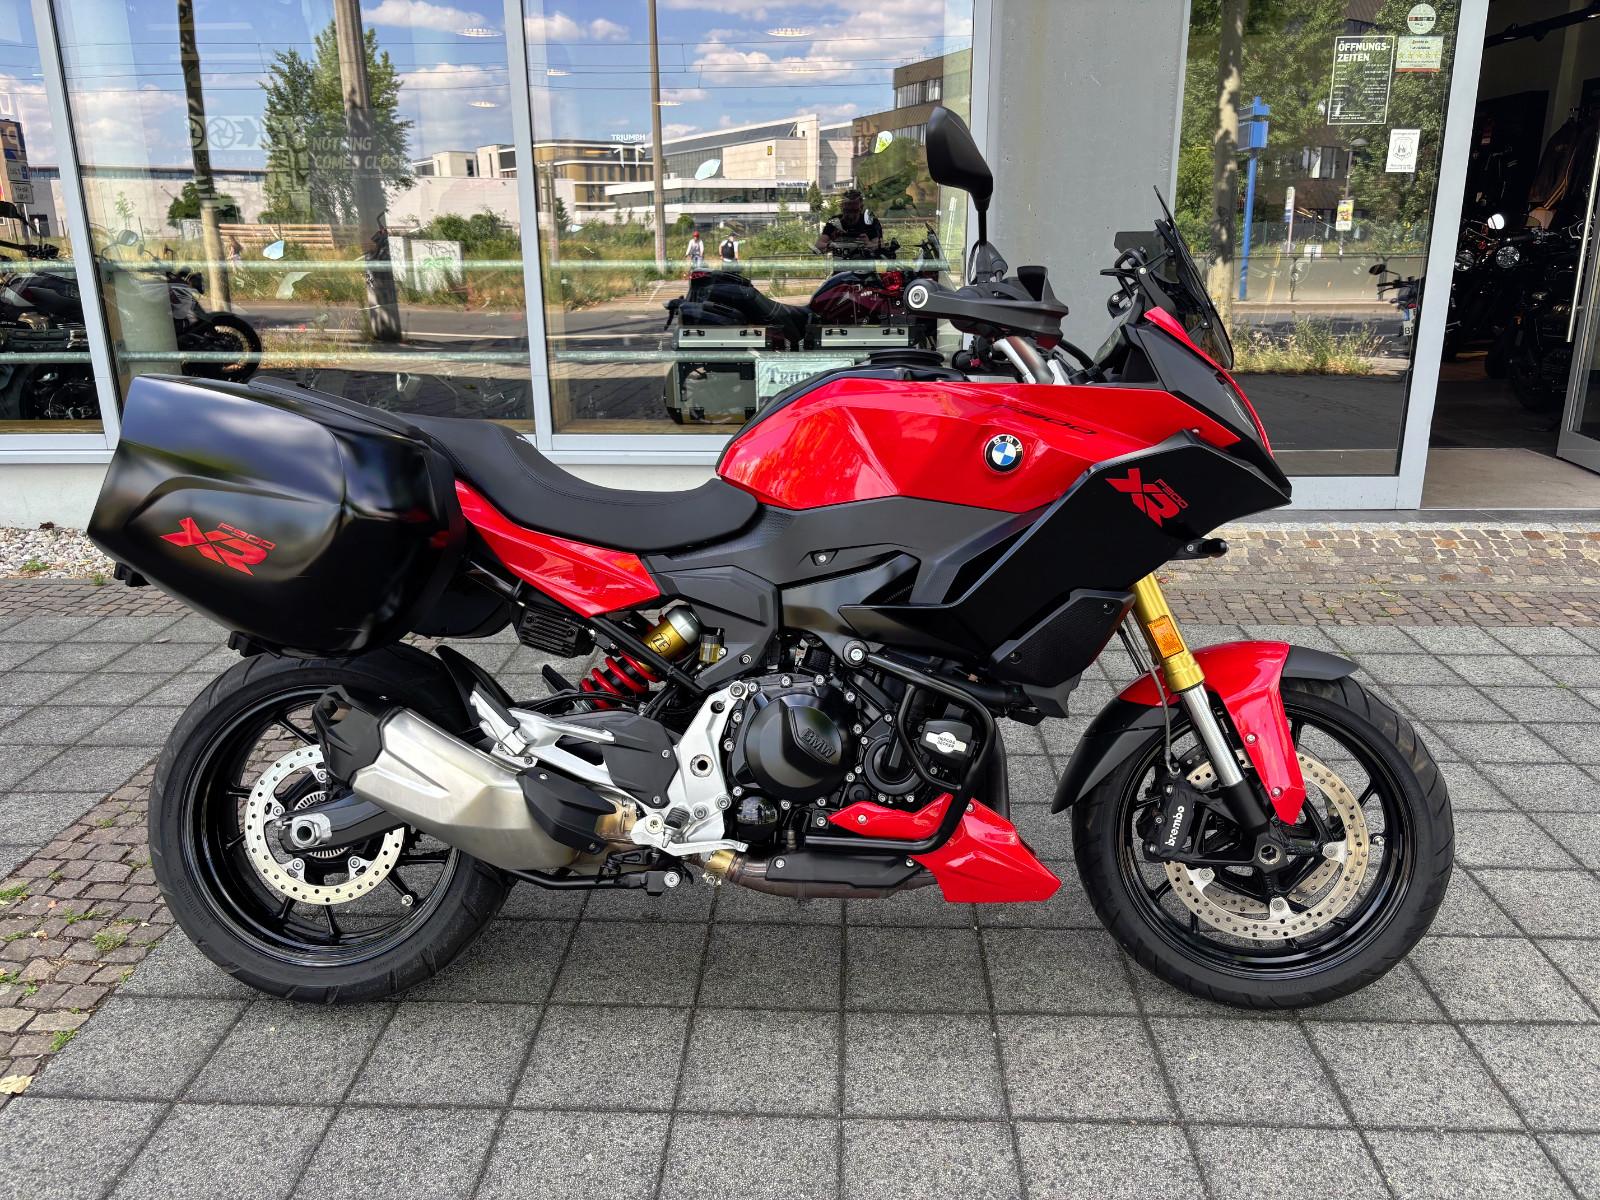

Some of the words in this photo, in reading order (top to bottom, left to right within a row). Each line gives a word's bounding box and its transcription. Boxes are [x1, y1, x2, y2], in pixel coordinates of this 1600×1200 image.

[1337, 53, 1370, 62] ZEITEN
[1338, 41, 1391, 52] ÖFFNUNGS-
[611, 134, 646, 142] TRIUMPH
[993, 435, 1023, 452] BMW
[1105, 467, 1180, 528] XR
[160, 517, 268, 576] XR
[217, 522, 277, 551] F900
[801, 728, 837, 759] BMW
[1164, 805, 1185, 847] brembo
